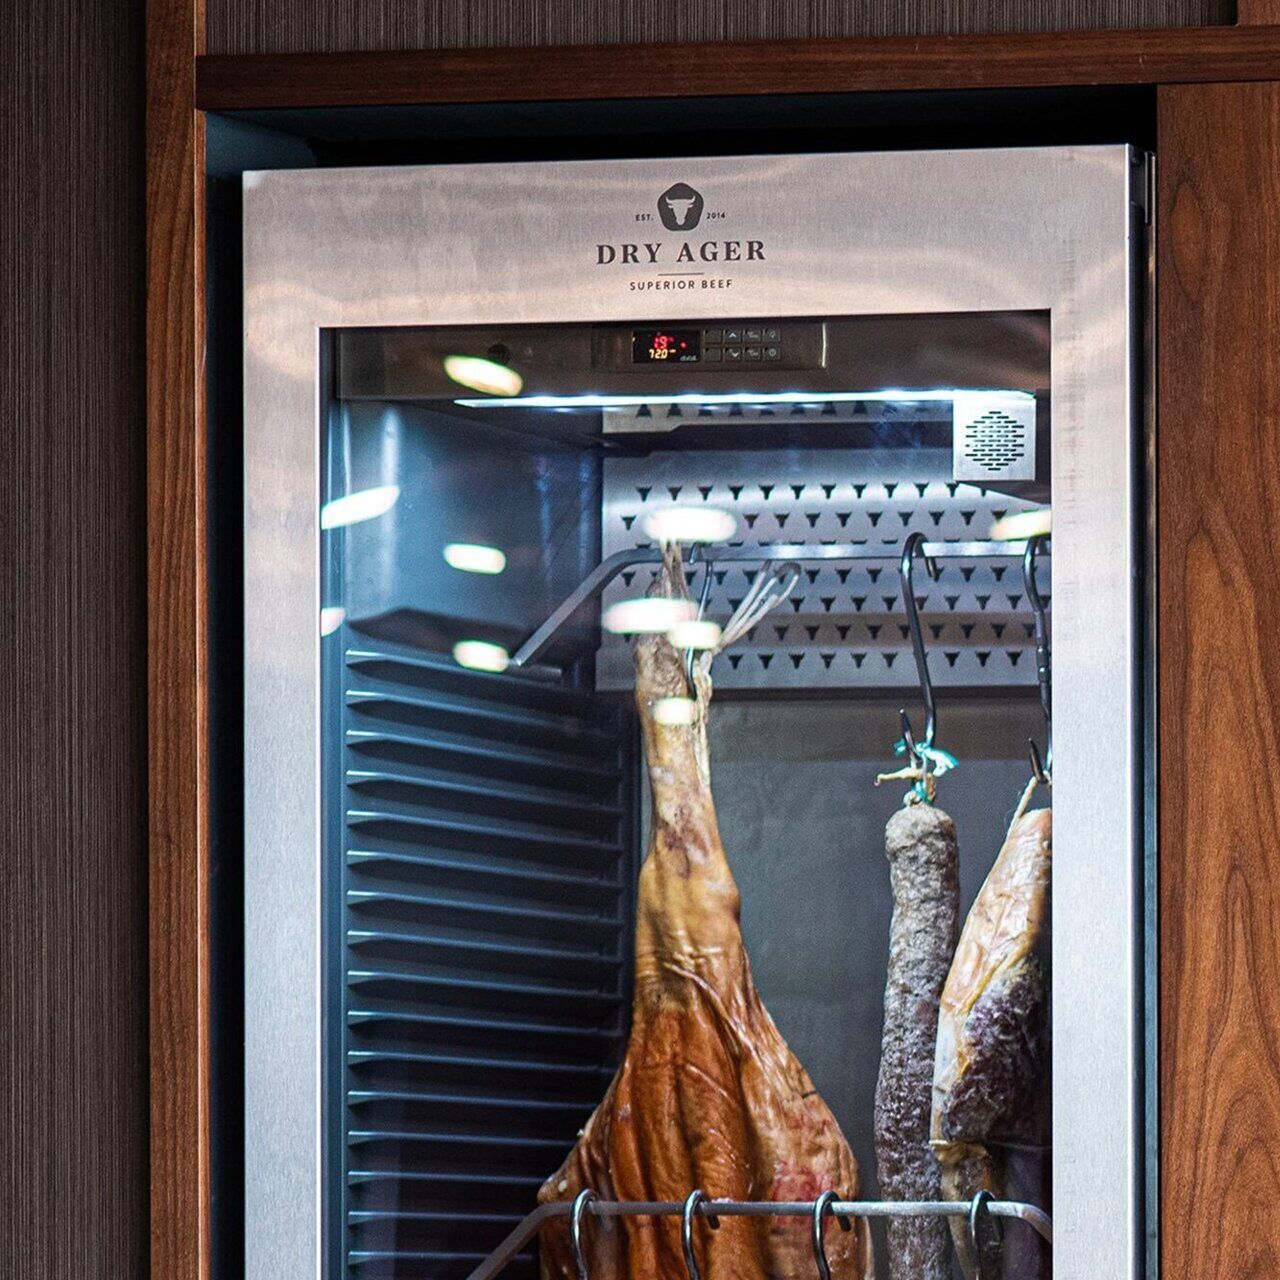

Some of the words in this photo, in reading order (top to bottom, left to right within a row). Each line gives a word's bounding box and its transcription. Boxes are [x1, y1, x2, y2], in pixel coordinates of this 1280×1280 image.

[635, 213, 654, 221] EST.
[597, 243, 661, 264] DRY
[677, 241, 765, 262] AGER
[630, 281, 694, 290] SUPERIOR
[702, 280, 731, 288] BEEF
